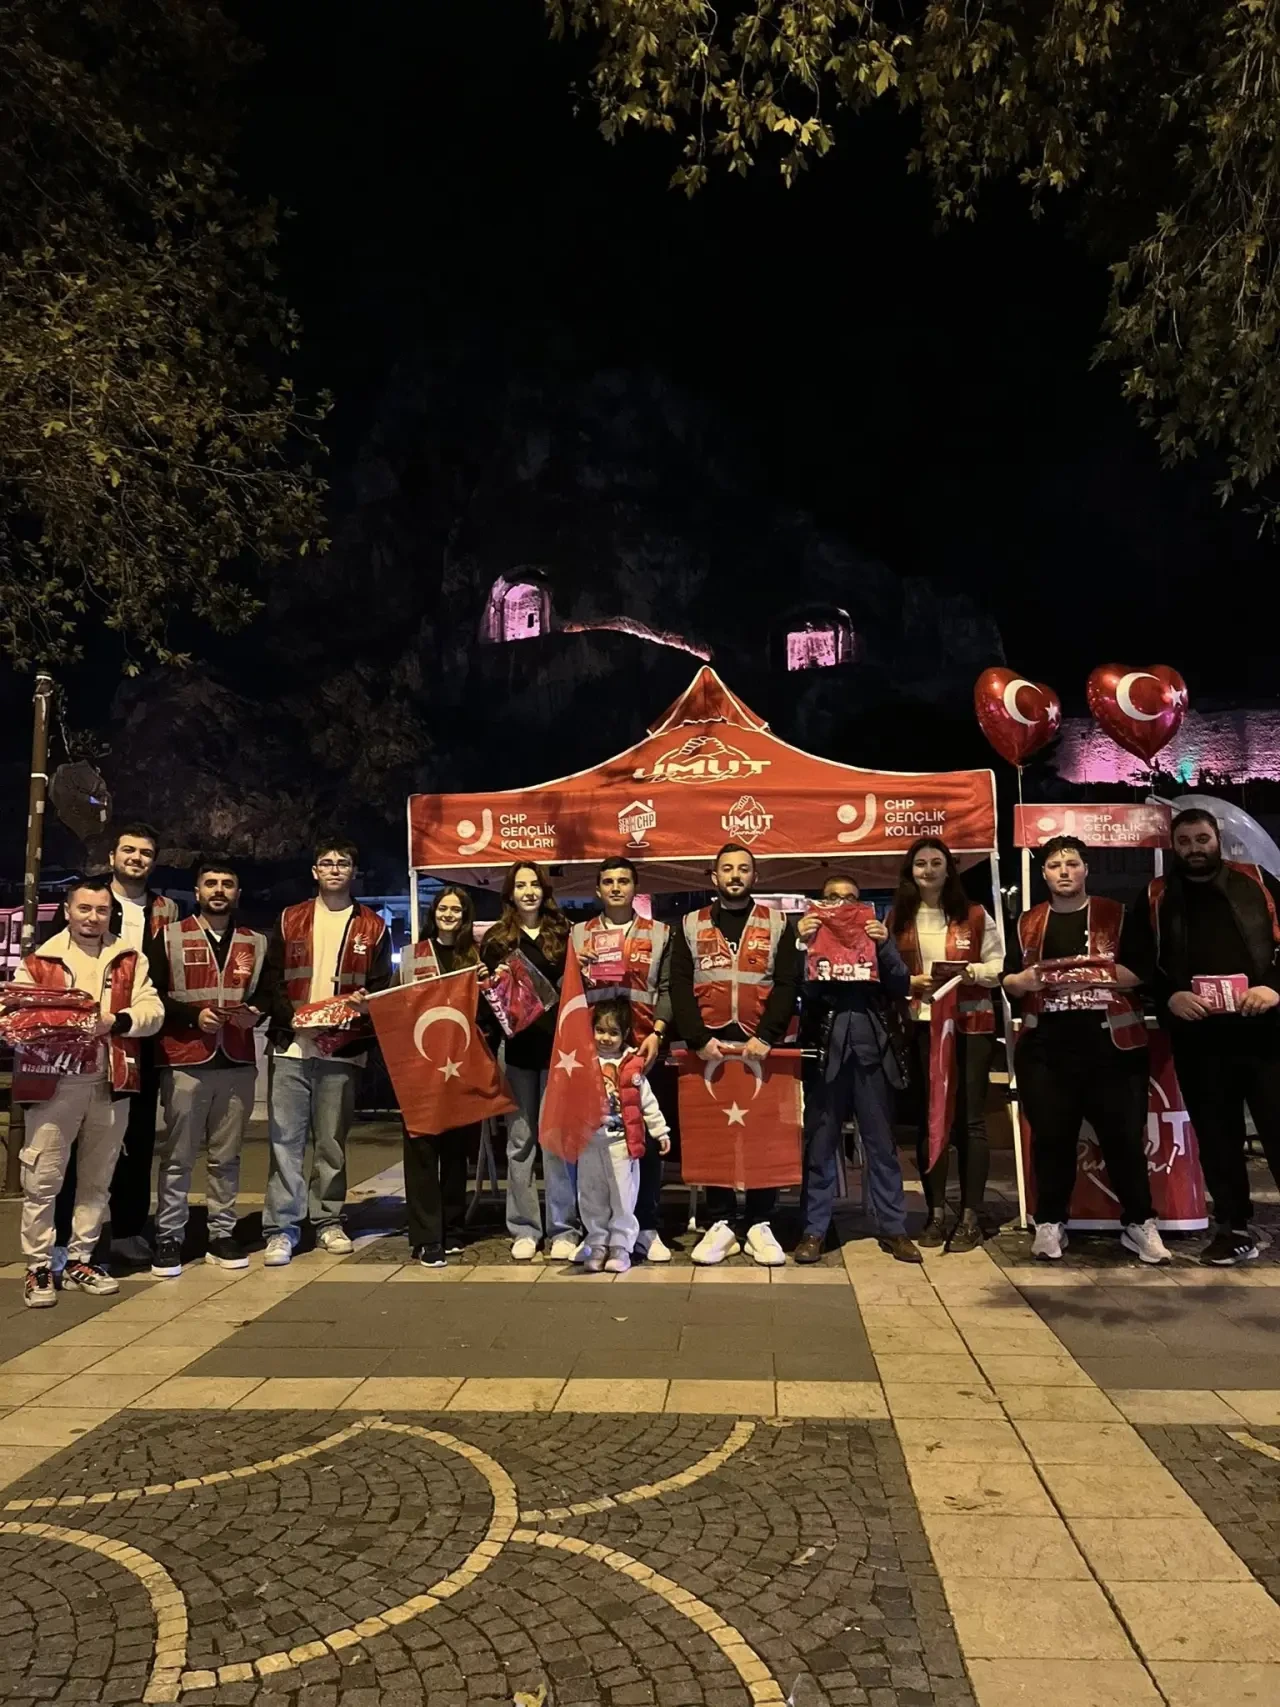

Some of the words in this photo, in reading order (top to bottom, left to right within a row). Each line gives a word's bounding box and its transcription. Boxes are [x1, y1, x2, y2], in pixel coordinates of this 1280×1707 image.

[633, 760, 772, 779] UMUT
[884, 799, 915, 811] CHP
[499, 813, 527, 825] CHP
[636, 813, 655, 829] CHP
[721, 814, 774, 831] UMUT
[884, 809, 946, 825] GENÇLİK
[1083, 815, 1113, 823] CHP
[500, 822, 556, 838] GENÇLİK
[884, 825, 943, 837] KOLLARI
[1083, 823, 1143, 836] GENÇLİK
[1083, 833, 1140, 842] KOLLARI
[501, 838, 554, 850] KOLLARI
